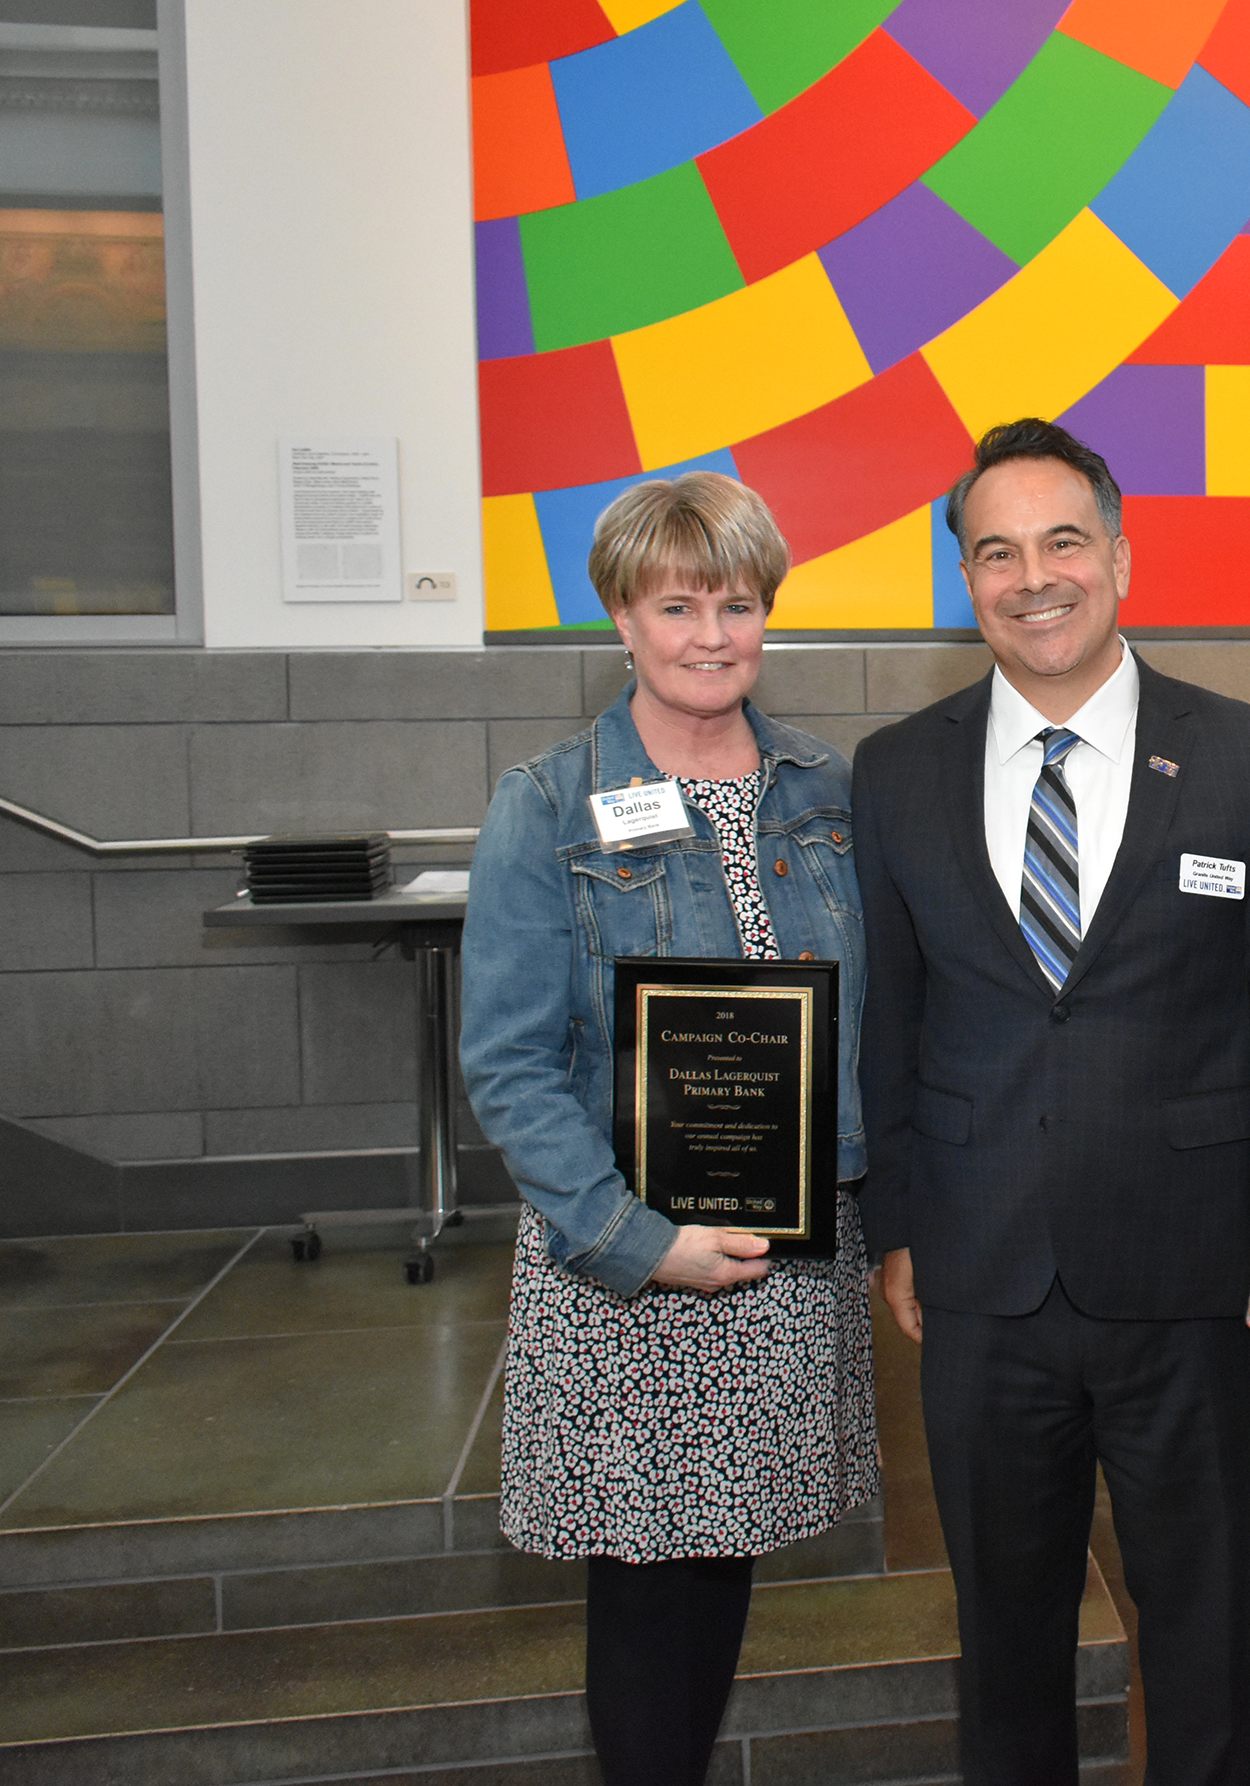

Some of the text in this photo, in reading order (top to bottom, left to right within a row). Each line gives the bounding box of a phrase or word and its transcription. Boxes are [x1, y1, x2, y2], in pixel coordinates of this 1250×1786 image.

[628, 788, 665, 799] LIVE UNITED
[612, 801, 661, 817] Dallas
[622, 813, 658, 825] Lagerquist
[1192, 859, 1236, 872] Patrick Tufts
[1183, 879, 1197, 889] LIVE
[661, 1030, 788, 1044] CAMPAIGN CO-CHAIR
[669, 1068, 780, 1082] DALLAS LAGERQUIST
[684, 1084, 765, 1097] PRIMARY BANK
[719, 1134, 751, 1142] campaign
[741, 1145, 749, 1153] of
[671, 1196, 695, 1209] LIVE
